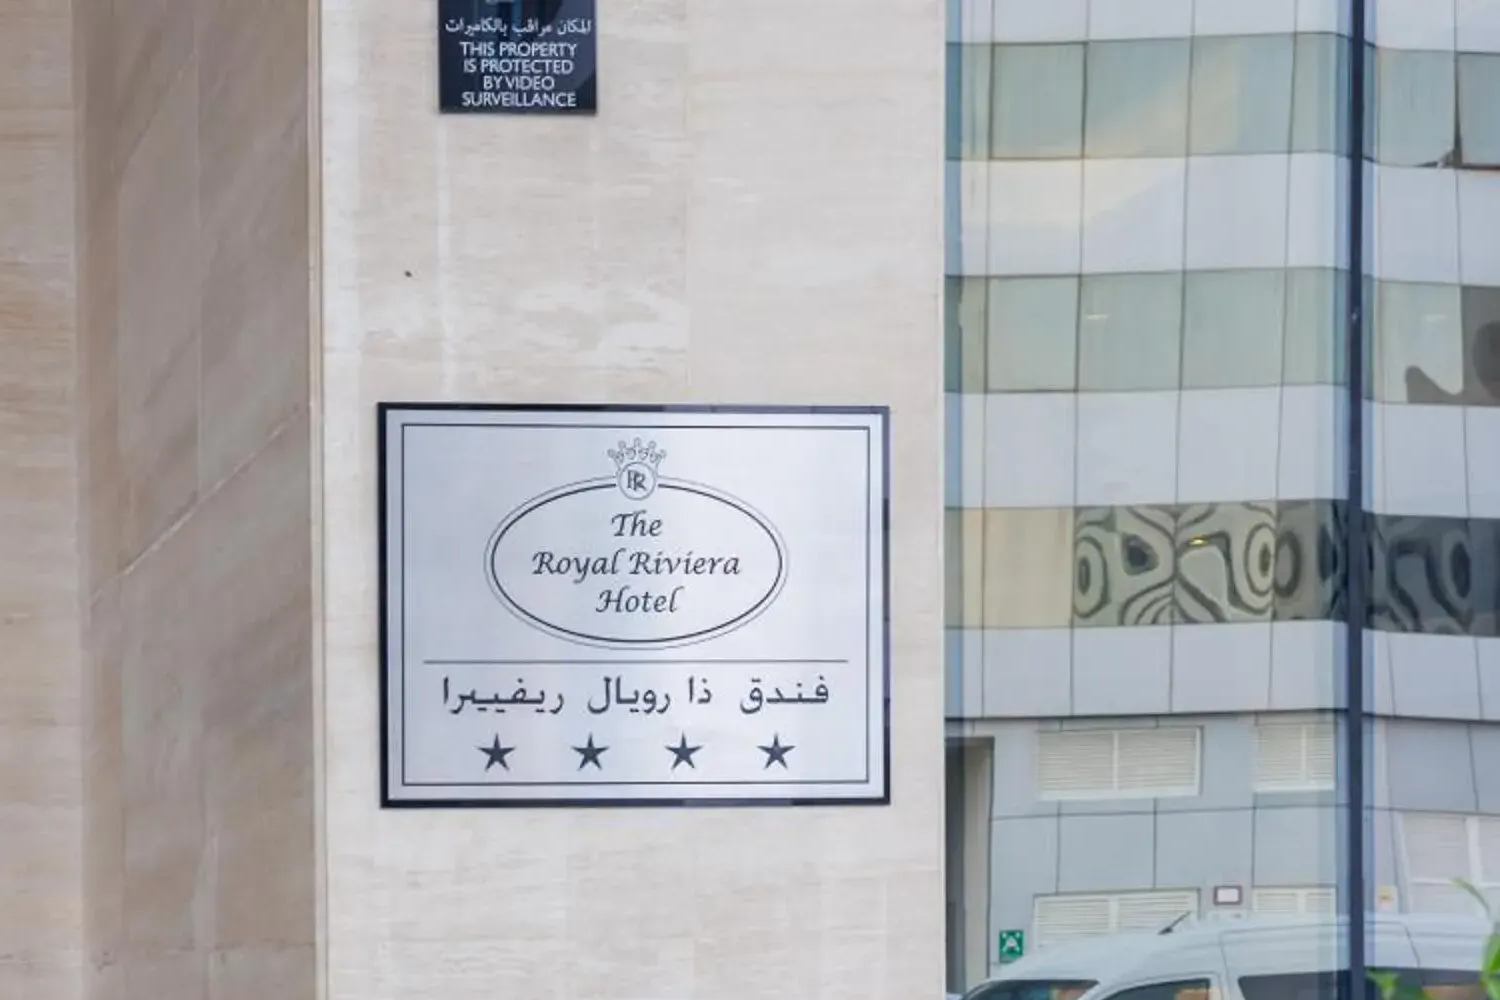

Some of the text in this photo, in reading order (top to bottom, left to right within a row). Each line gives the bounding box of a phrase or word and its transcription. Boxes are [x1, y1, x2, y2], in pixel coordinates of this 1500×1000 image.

[459, 42, 578, 57] THIS PROPERTY
[463, 59, 573, 74] IS PROTECTED
[483, 76, 555, 90] BY VIDEO
[461, 92, 577, 107] SURVEILLANCE
[611, 509, 663, 537] The
[532, 548, 740, 584] Royal Riviera
[595, 585, 684, 613] Hotel
[443, 676, 830, 714] فندق ذا رويال ريفييرا
